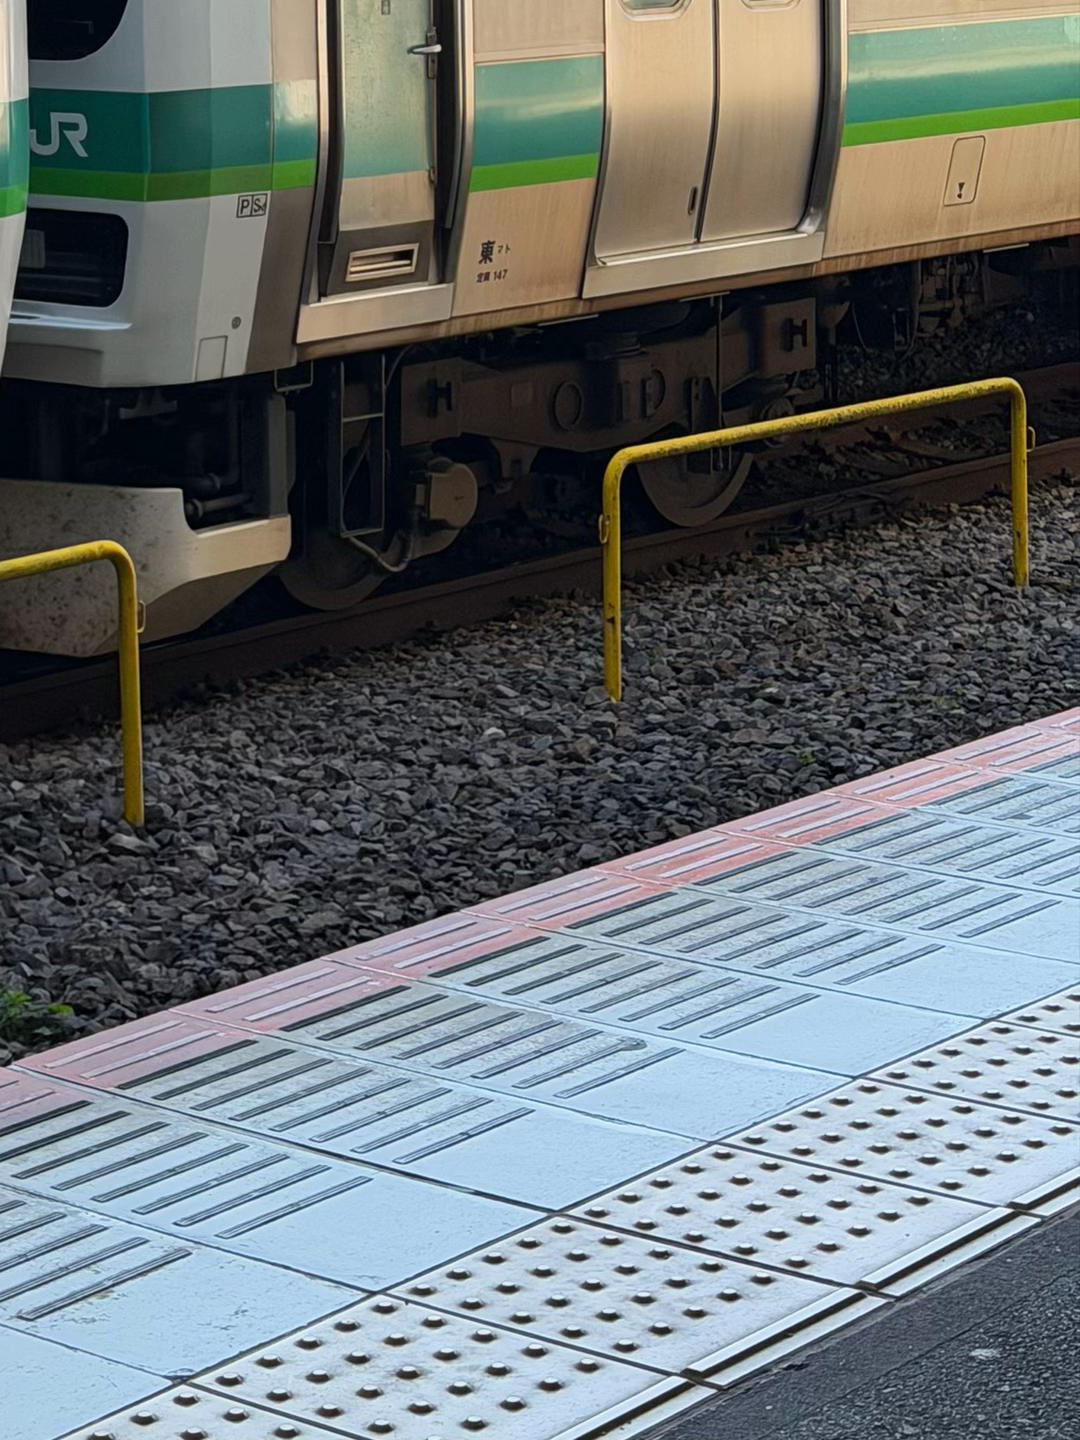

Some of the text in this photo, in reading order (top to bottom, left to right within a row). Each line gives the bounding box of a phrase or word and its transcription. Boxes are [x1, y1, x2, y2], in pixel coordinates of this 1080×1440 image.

[29, 111, 89, 158] JR
[478, 240, 496, 264] 東
[493, 269, 508, 281] 147
